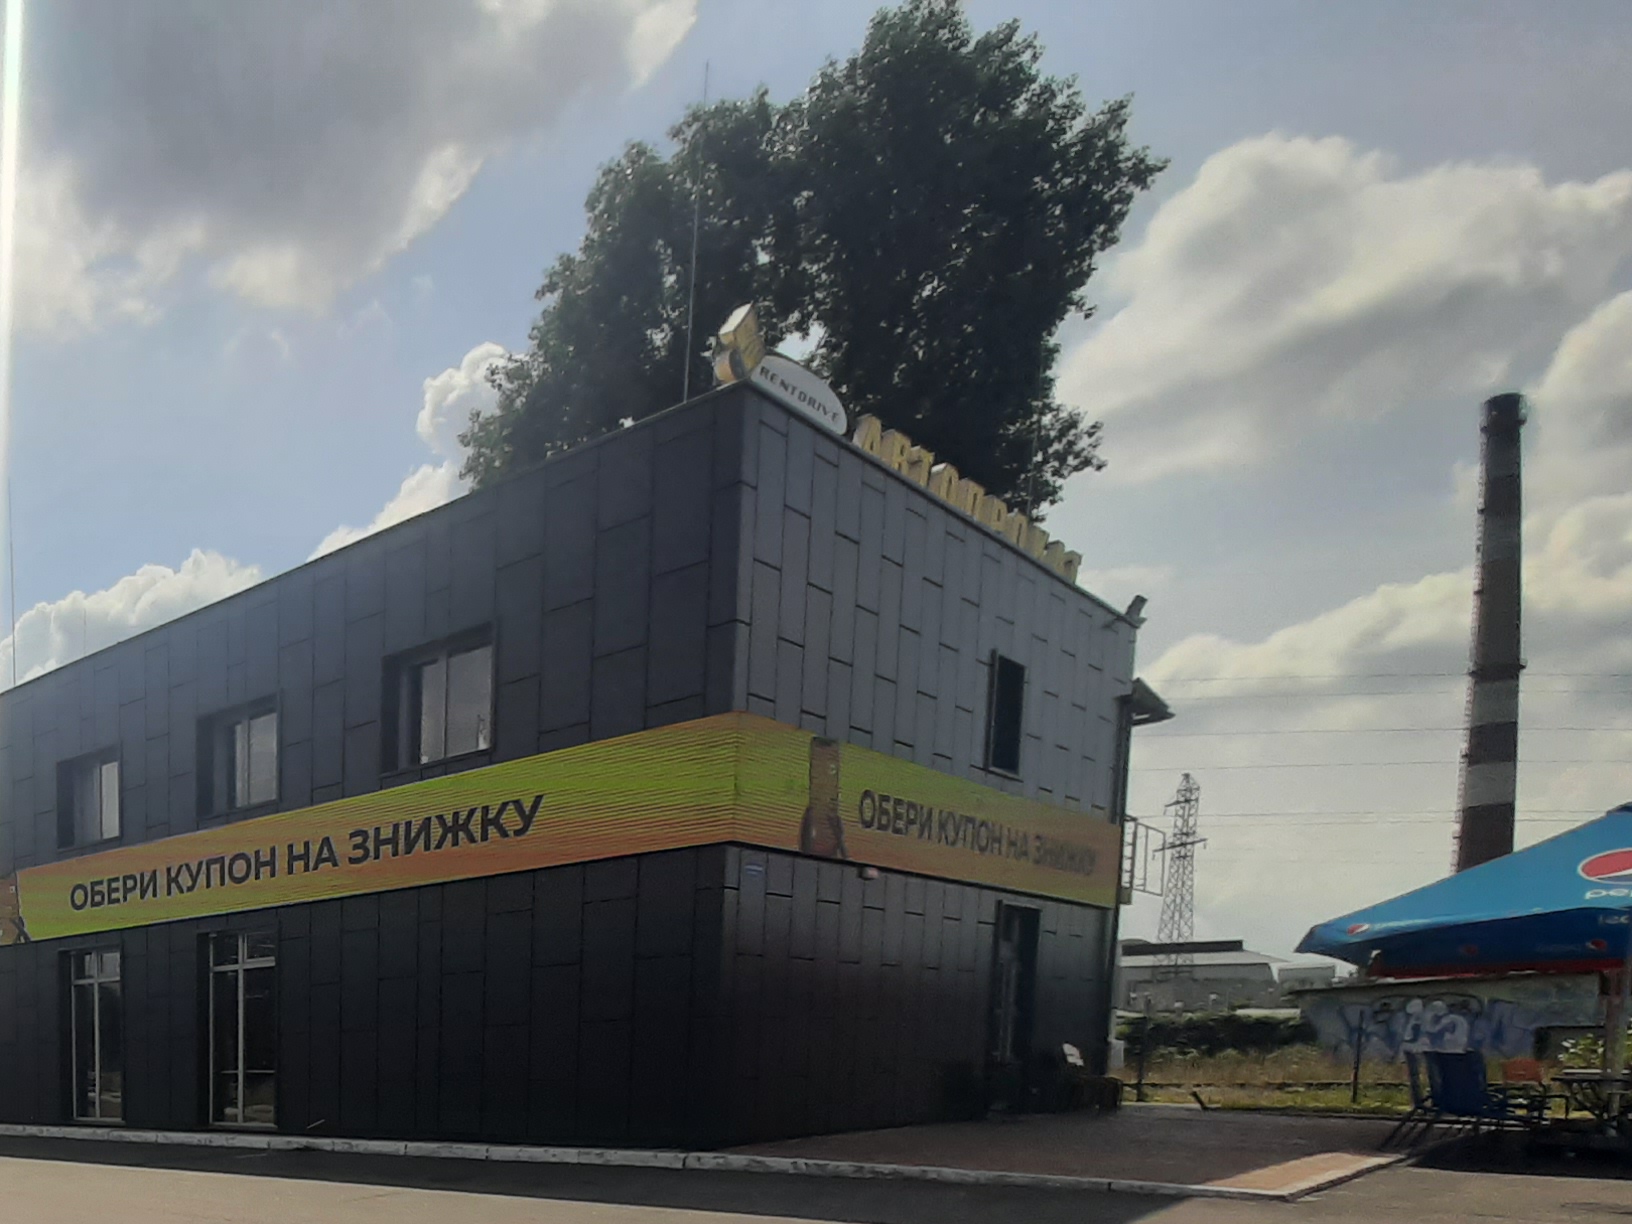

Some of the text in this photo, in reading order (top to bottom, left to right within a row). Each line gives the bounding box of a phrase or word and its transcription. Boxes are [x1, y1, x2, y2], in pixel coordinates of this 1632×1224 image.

[69, 795, 545, 911] ОБЕРИ КУПОН НА ЗНИЖКУ
[859, 789, 933, 840] ОБЕРИ
[937, 809, 1002, 855] КУПОН
[1006, 827, 1029, 861] НА
[1584, 888, 1632, 900] pe
